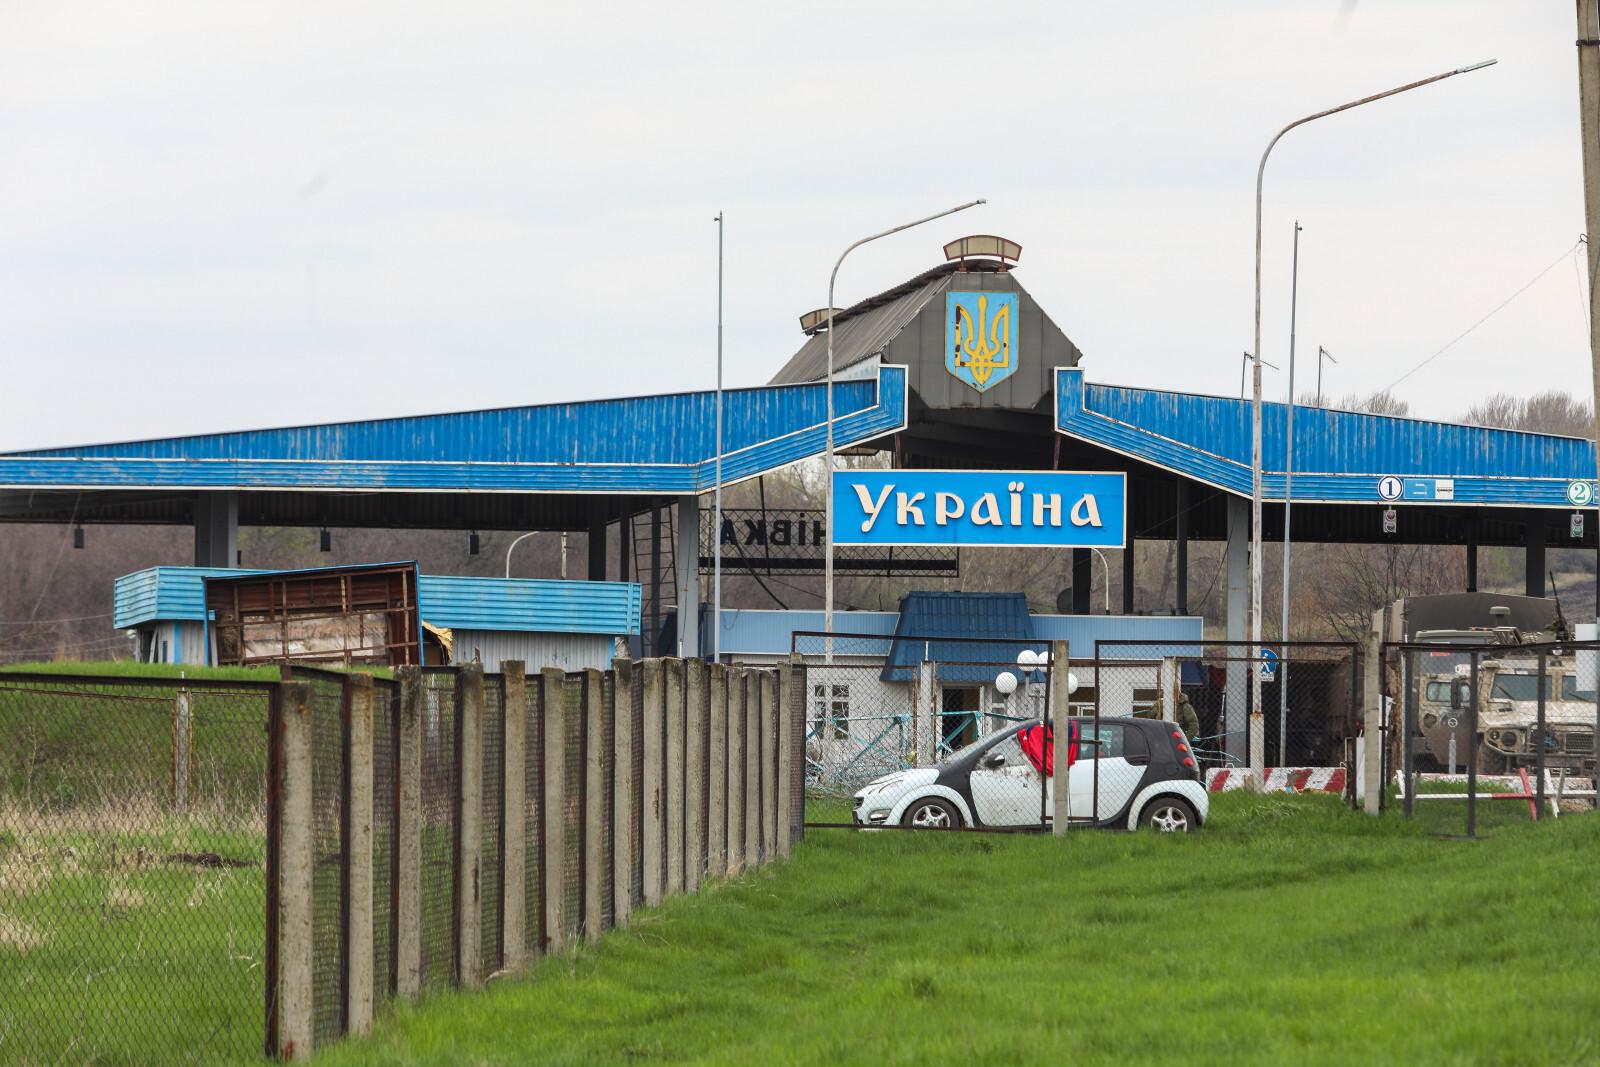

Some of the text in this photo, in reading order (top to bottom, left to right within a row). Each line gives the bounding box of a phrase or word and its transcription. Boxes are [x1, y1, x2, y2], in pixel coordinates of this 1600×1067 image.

[1385, 479, 1396, 497] 1
[1574, 484, 1586, 501] 2
[851, 481, 1103, 533] Україна
